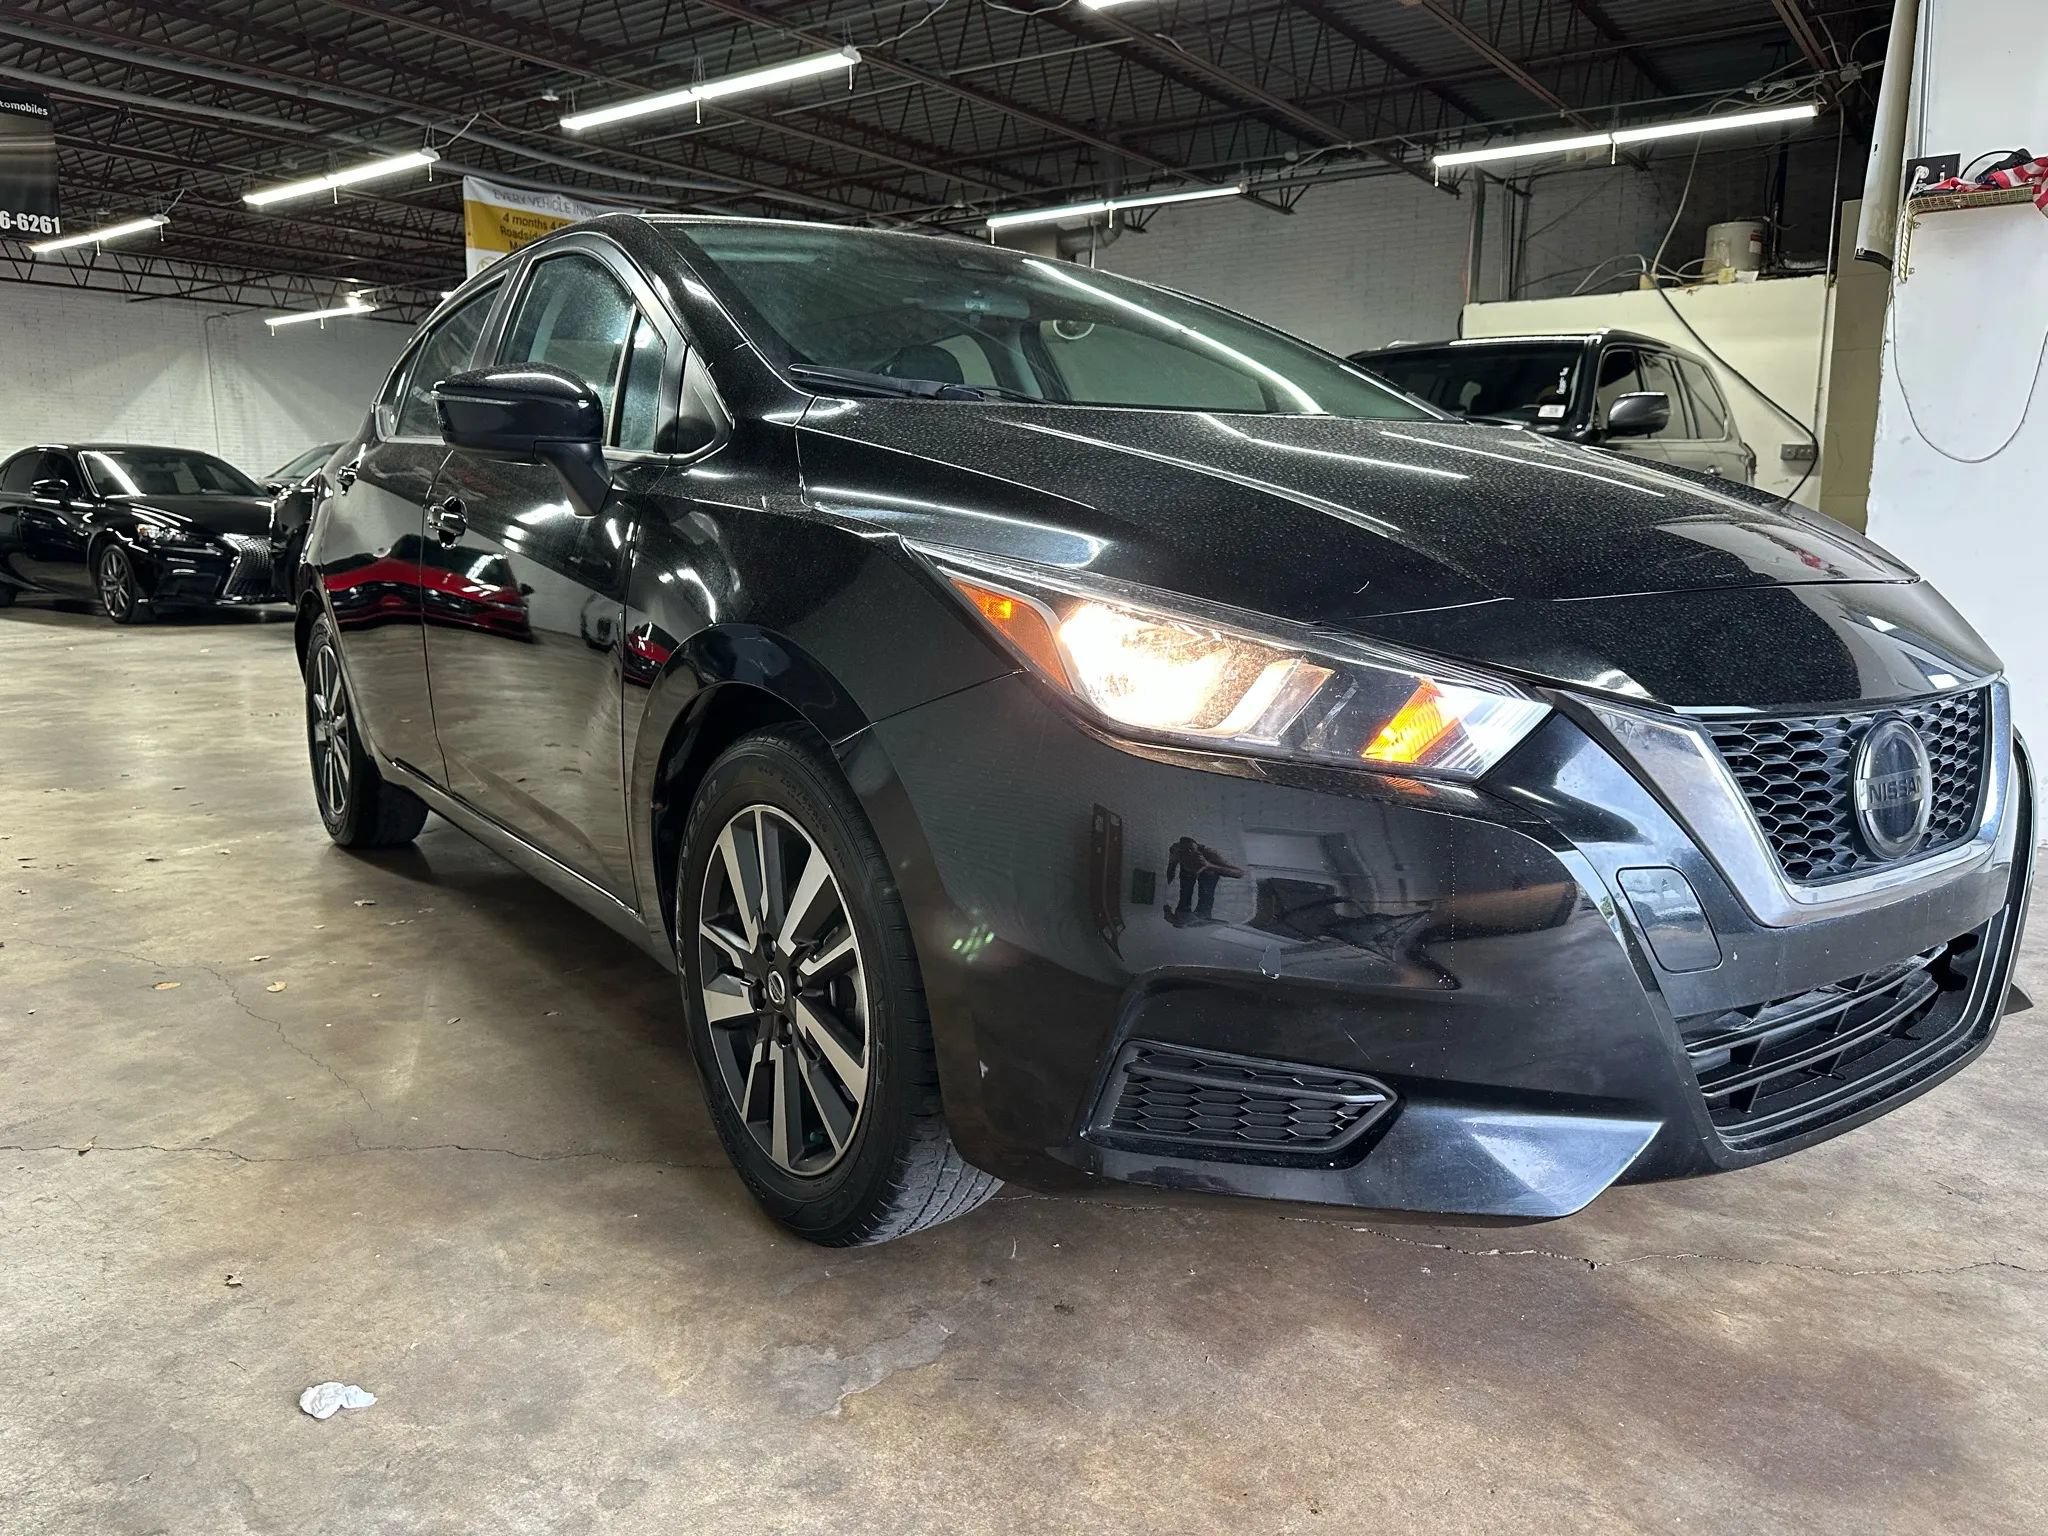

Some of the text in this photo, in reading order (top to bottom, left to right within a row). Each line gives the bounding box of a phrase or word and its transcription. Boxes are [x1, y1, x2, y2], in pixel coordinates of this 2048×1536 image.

[503, 212, 510, 223] 4
[512, 216, 548, 231] months
[500, 225, 541, 241] Roadsid
[1869, 775, 1922, 804] NISSAN
